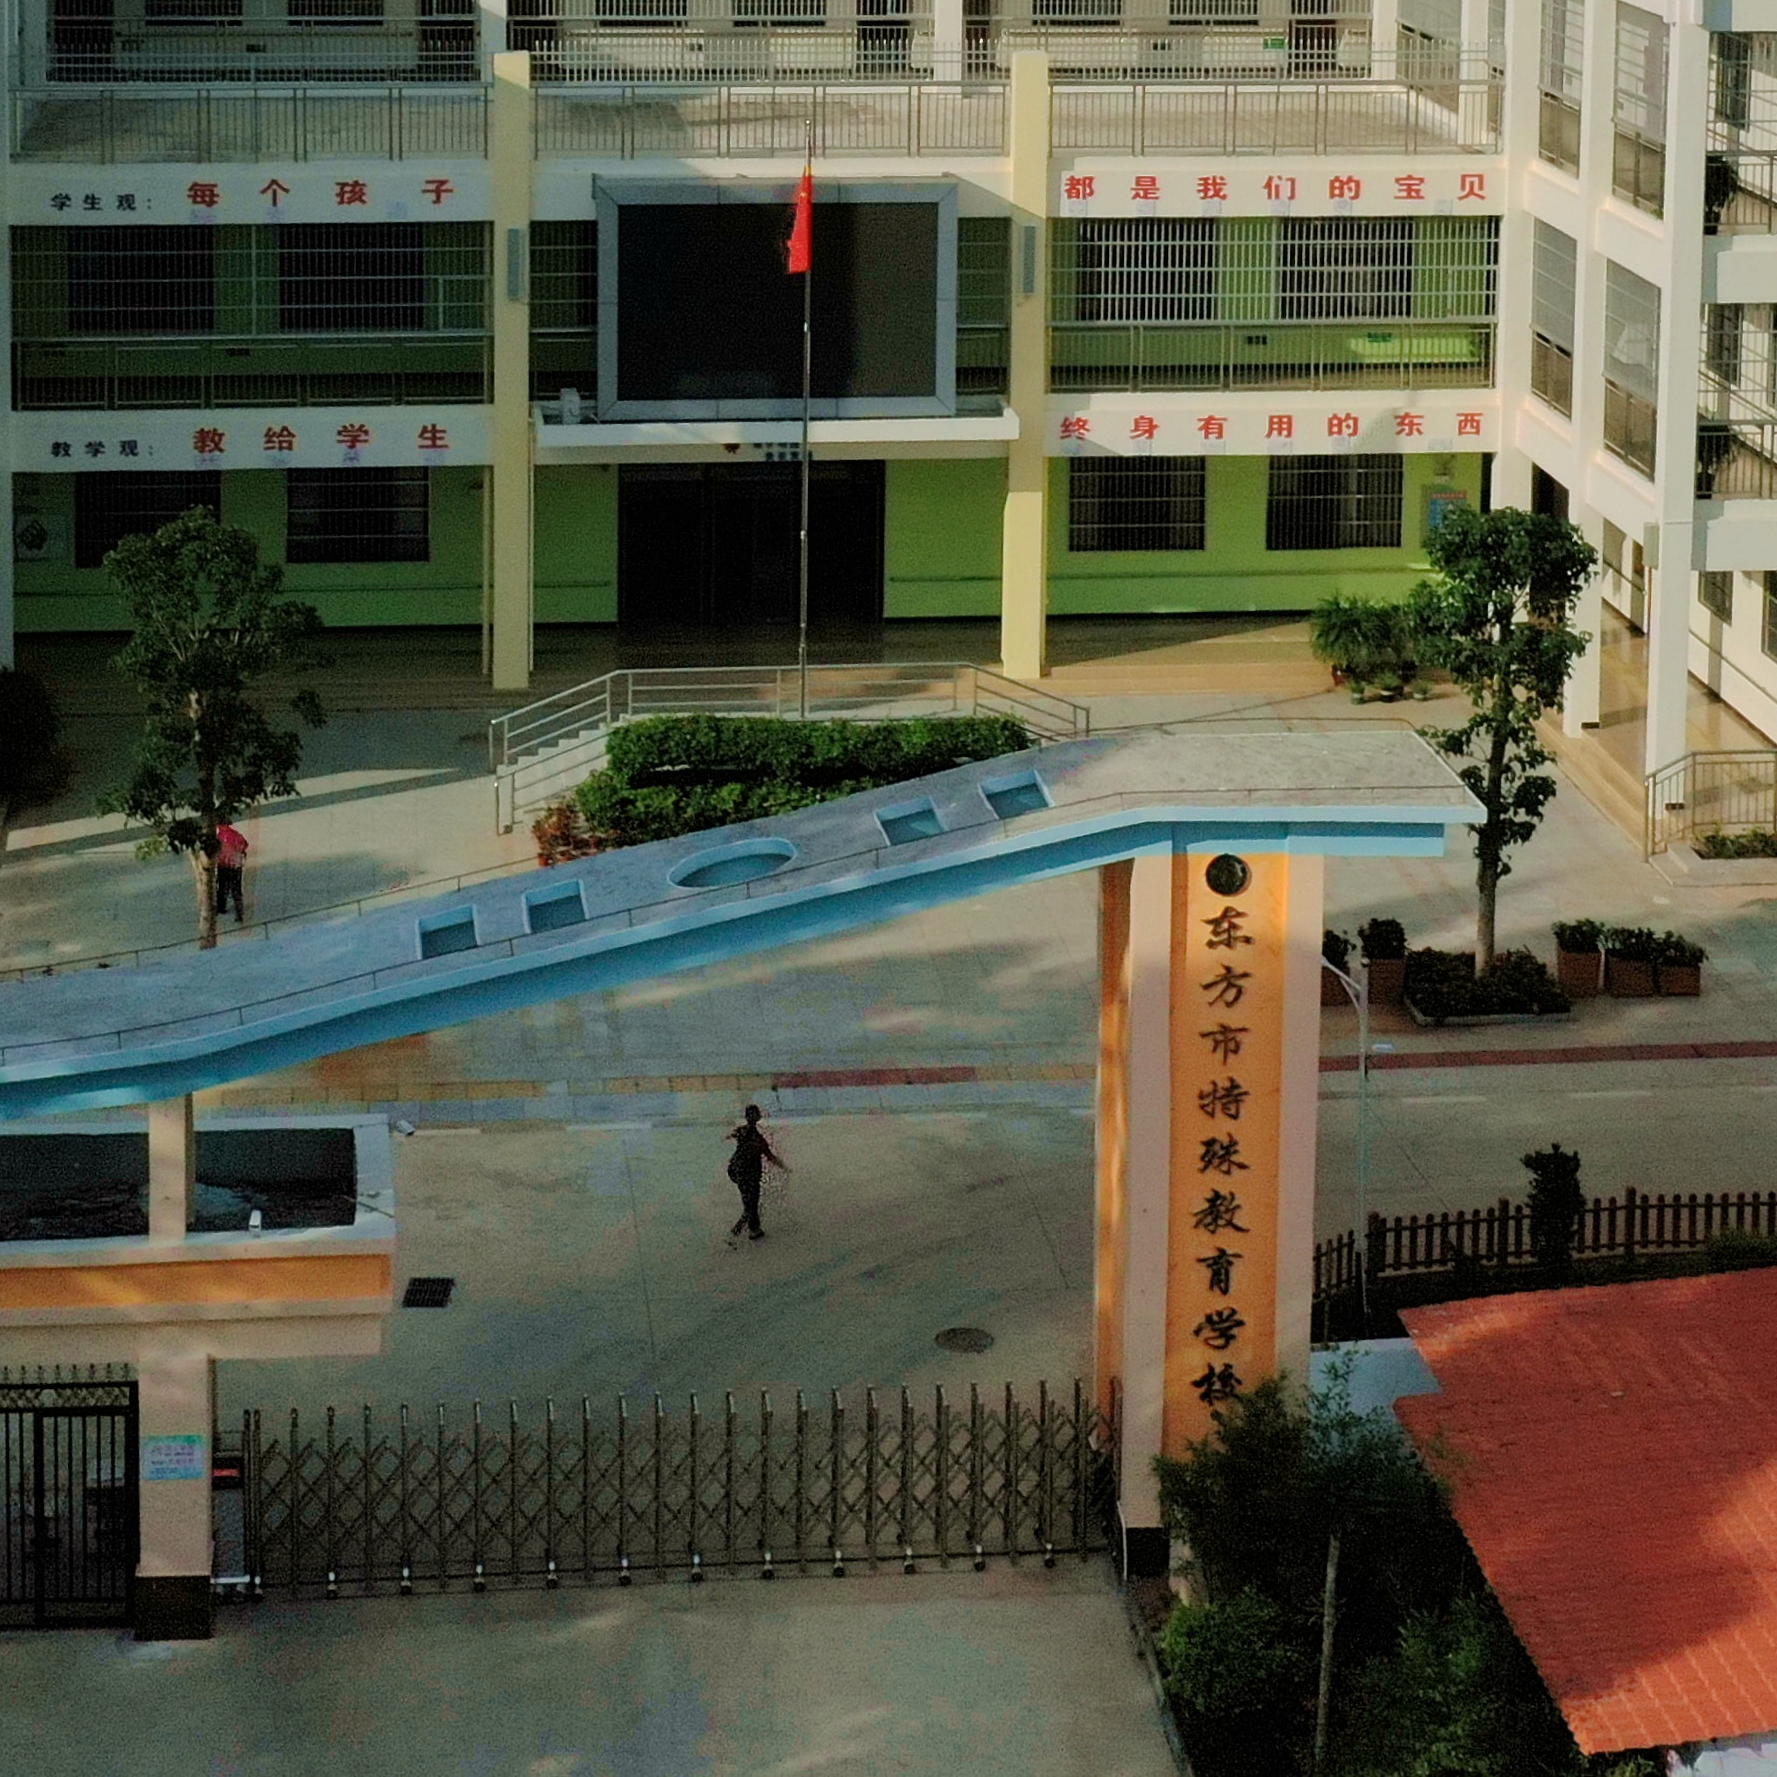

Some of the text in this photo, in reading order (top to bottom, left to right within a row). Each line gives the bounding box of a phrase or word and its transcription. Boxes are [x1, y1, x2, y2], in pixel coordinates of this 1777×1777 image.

[50, 177, 454, 212] 学生观： 每个孩子
[1065, 174, 1487, 201] 都是我们的宝贝
[50, 424, 450, 458] 教学观： 教给学生
[1060, 413, 1482, 441] 终身有用的东西
[1190, 905, 1253, 1410] 东方市特殊教育学校
